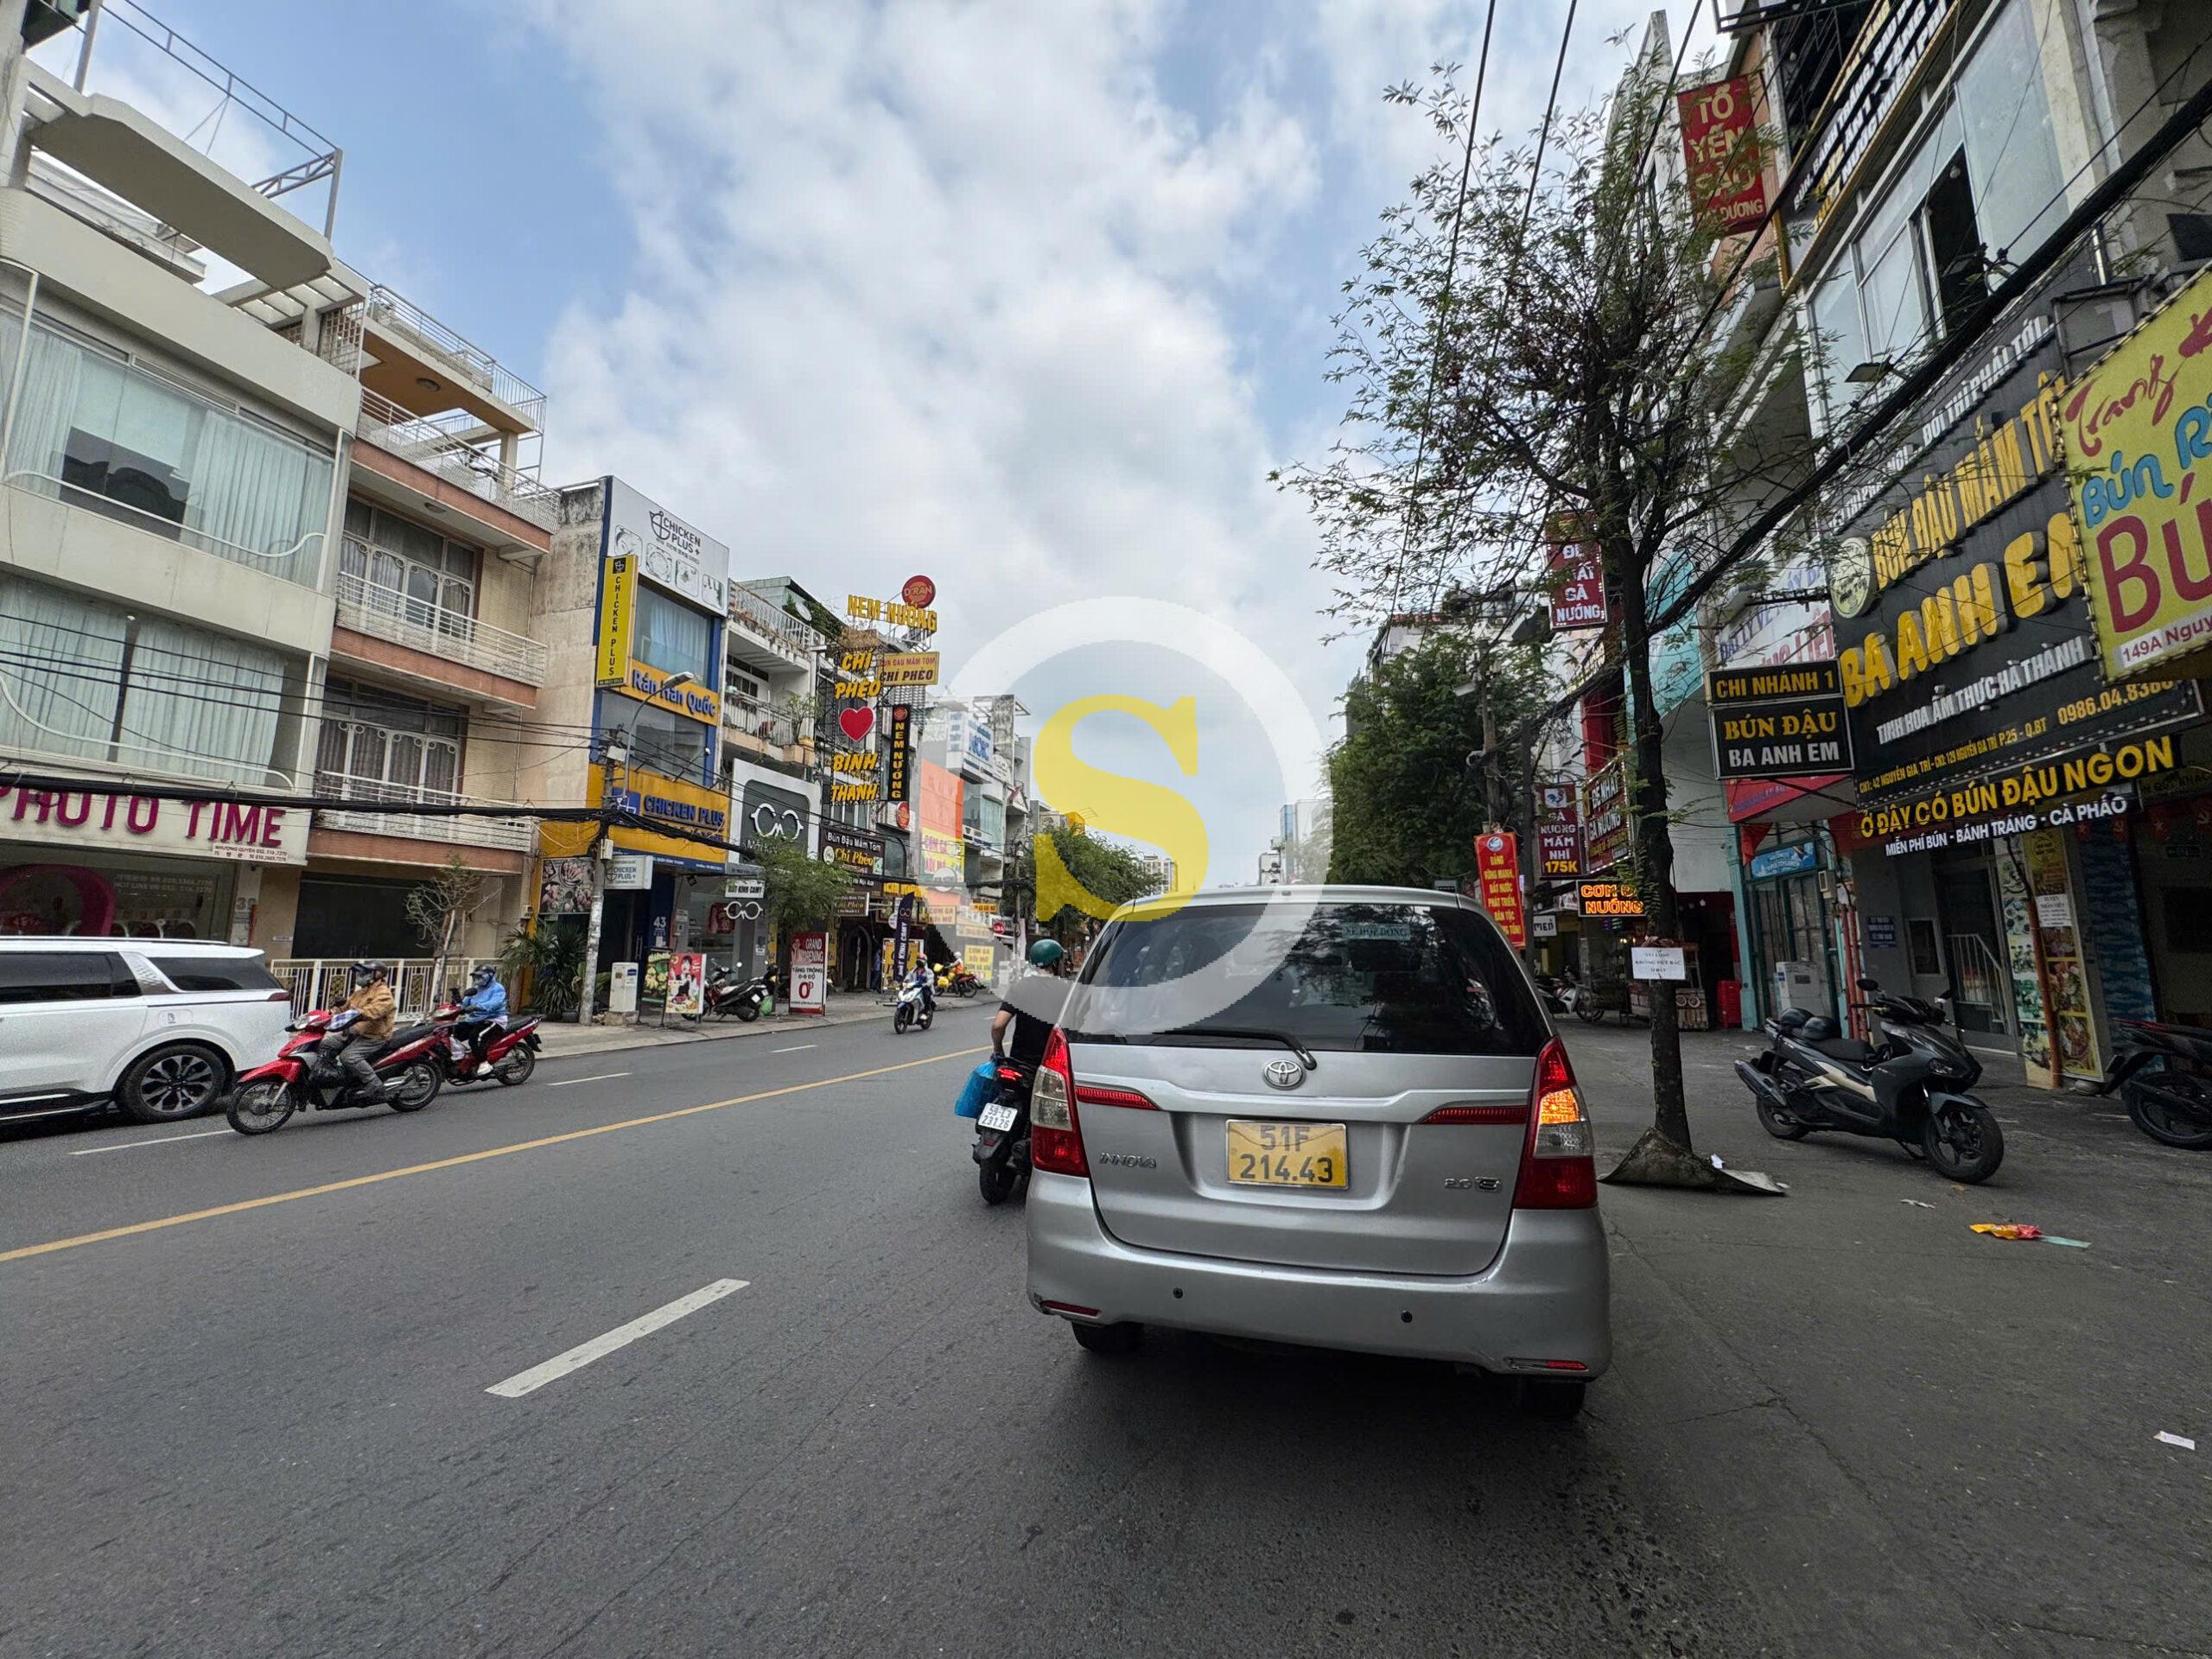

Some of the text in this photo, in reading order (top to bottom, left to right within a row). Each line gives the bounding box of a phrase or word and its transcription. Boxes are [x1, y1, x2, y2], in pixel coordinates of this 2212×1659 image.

[664, 518, 701, 547] CHICKEN
[609, 575, 621, 632] CHICKEN
[1897, 563, 1998, 681] ANH
[607, 639, 618, 676] PLUS
[2122, 636, 2163, 663] 149A
[1715, 670, 1834, 698] CHI NHÁNH 1
[1723, 708, 1837, 741] BÚN ĐẬU
[1728, 741, 1840, 768] BA ANH EM
[1952, 779, 1998, 818] BÚN
[2063, 735, 2174, 792] NGON
[1545, 861, 1577, 873] 175K
[1260, 1124, 1311, 1153] 51F
[1239, 1154, 1333, 1184] 214.43
